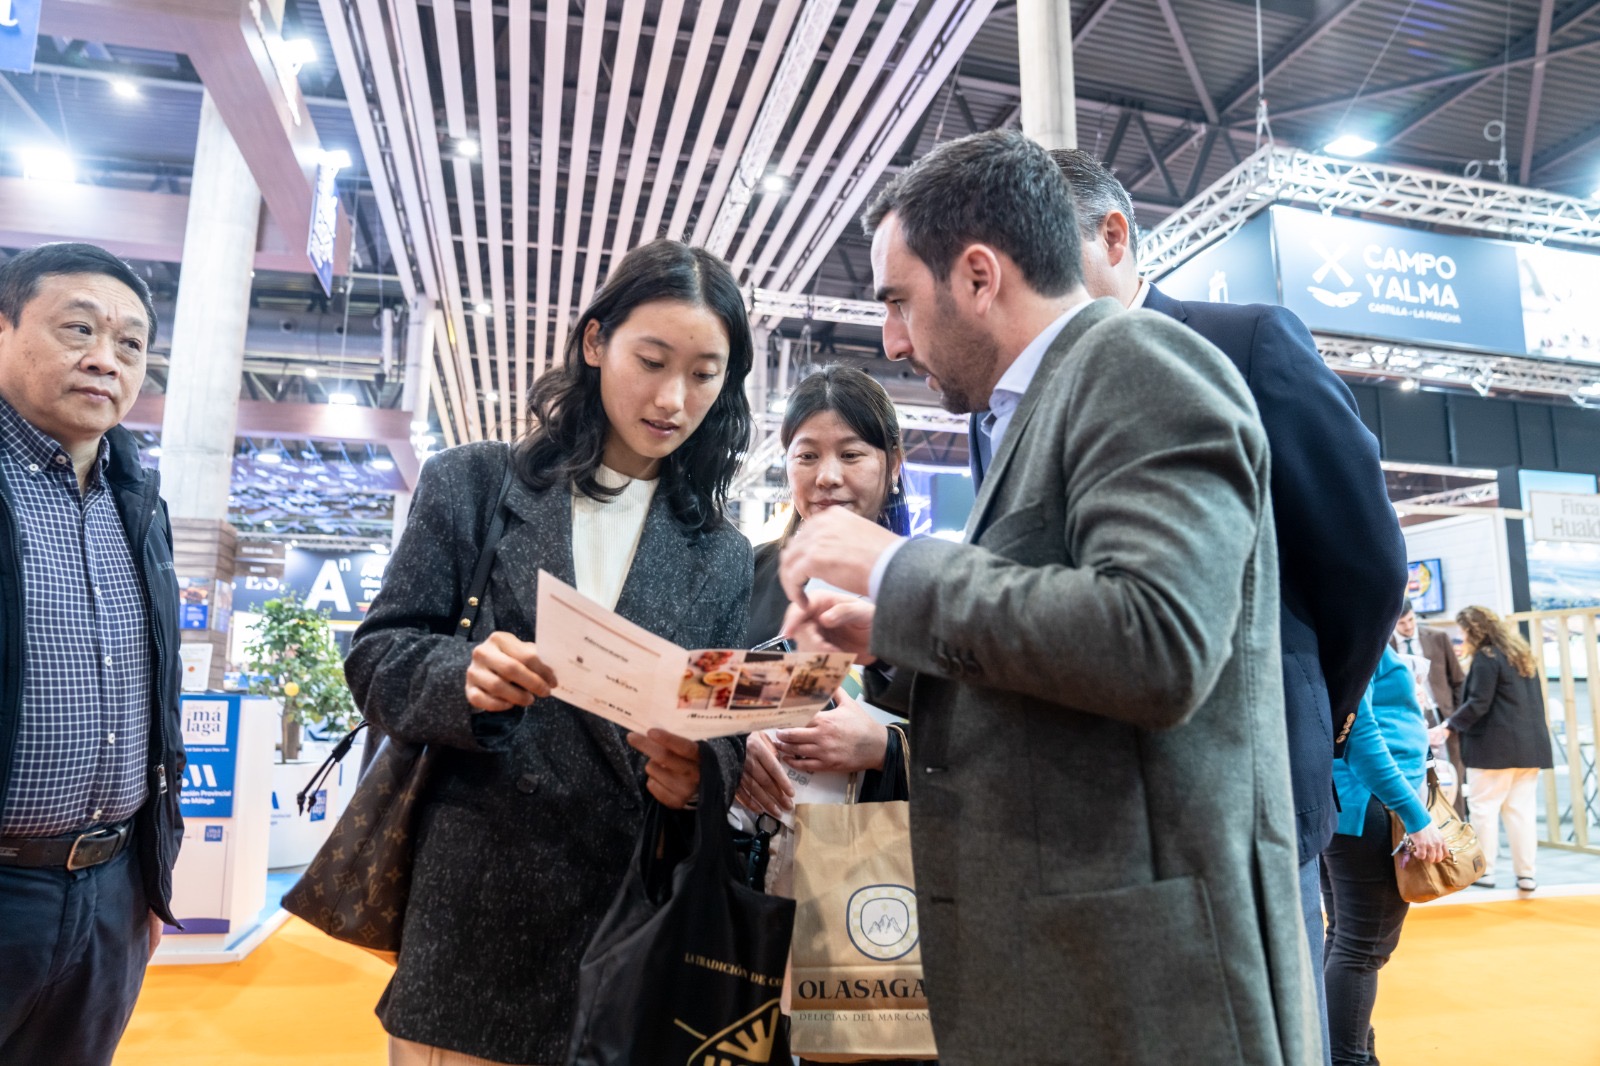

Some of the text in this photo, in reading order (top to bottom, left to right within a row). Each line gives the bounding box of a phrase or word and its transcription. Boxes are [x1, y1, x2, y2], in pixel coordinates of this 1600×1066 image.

[1363, 244, 1457, 280] CAMPO
[1367, 302, 1408, 316] CASTILLA
[1412, 308, 1425, 319] LA
[1425, 310, 1462, 324] MANCHA
[1561, 499, 1599, 517] Finca
[191, 797, 215, 805] Málaga
[200, 789, 232, 797] Provincial
[695, 955, 748, 979] TRADICIÓN
[750, 971, 766, 986] DE
[799, 1013, 848, 1022] DELICIAS
[853, 1013, 874, 1022] DEL
[878, 1013, 901, 1022] MAR
